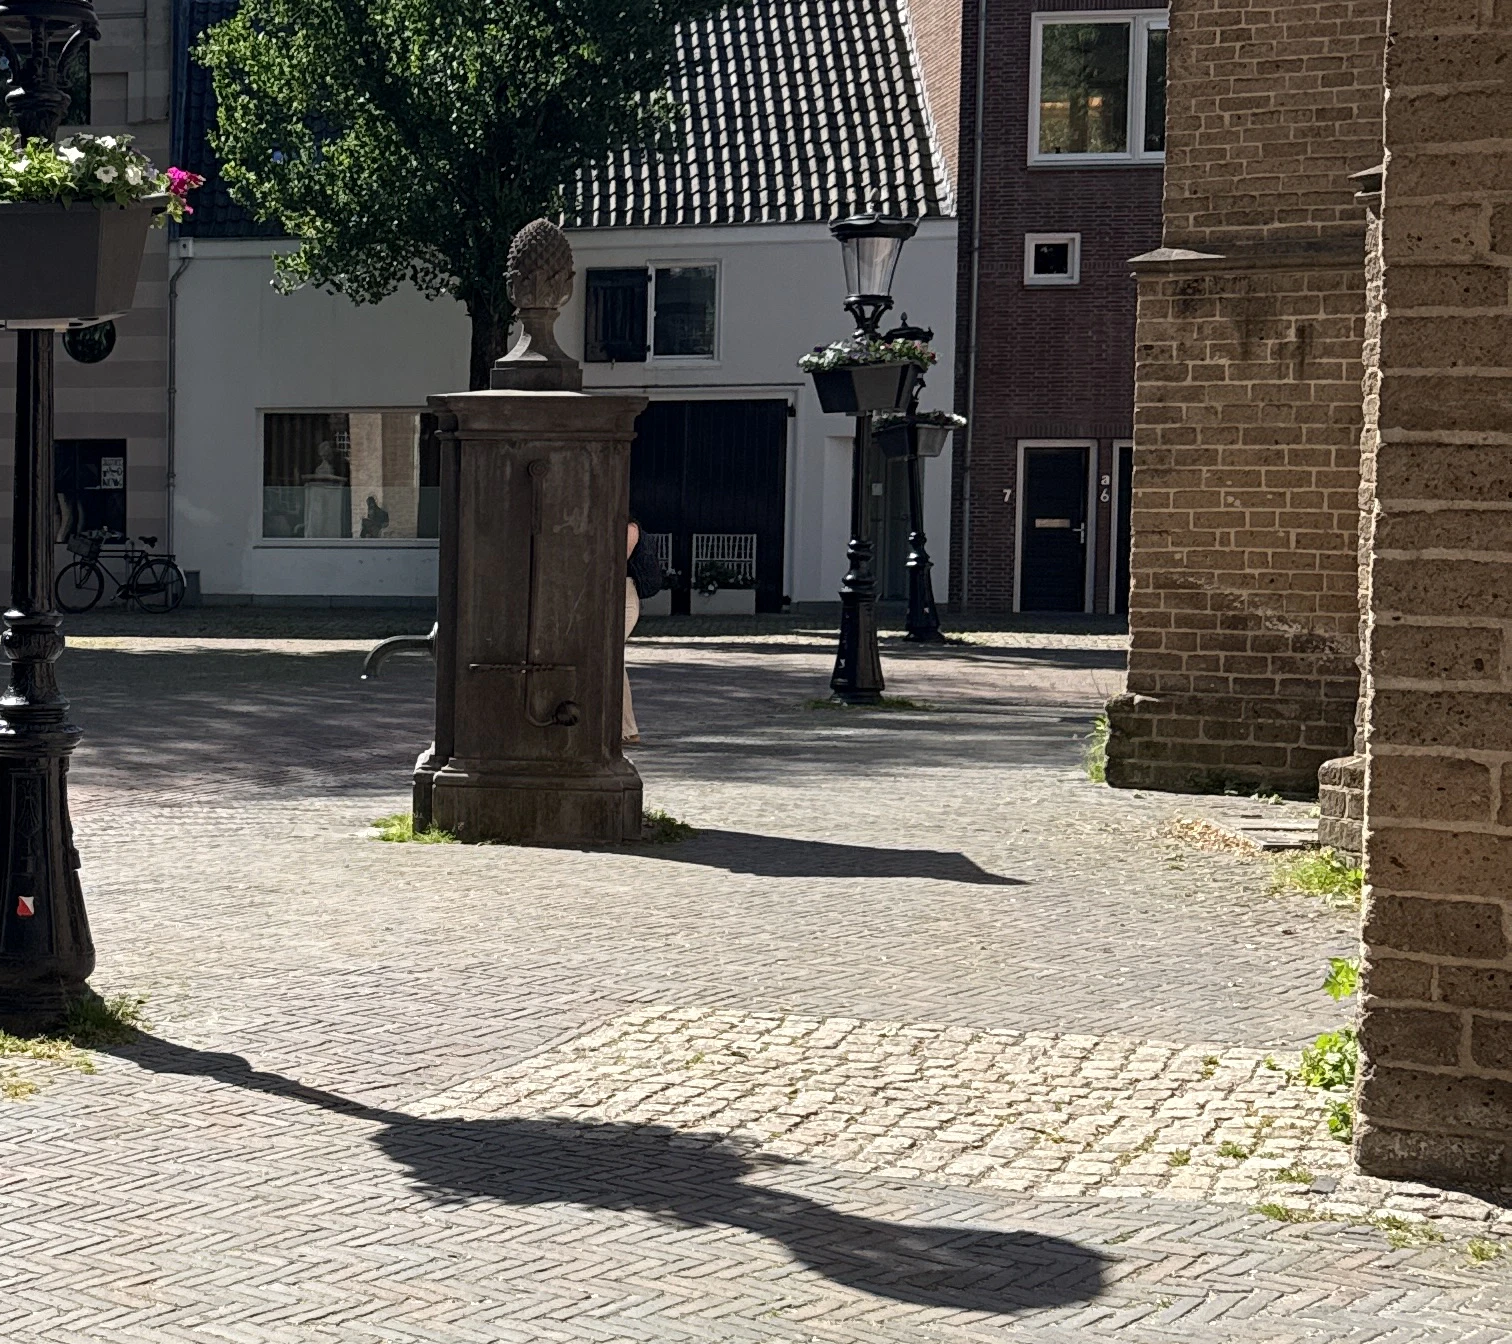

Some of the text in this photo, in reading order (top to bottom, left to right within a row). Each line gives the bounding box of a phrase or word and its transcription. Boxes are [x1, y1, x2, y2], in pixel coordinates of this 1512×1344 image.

[1100, 474, 1110, 486] a
[1002, 488, 1012, 503] 7
[1099, 488, 1110, 503] 6
